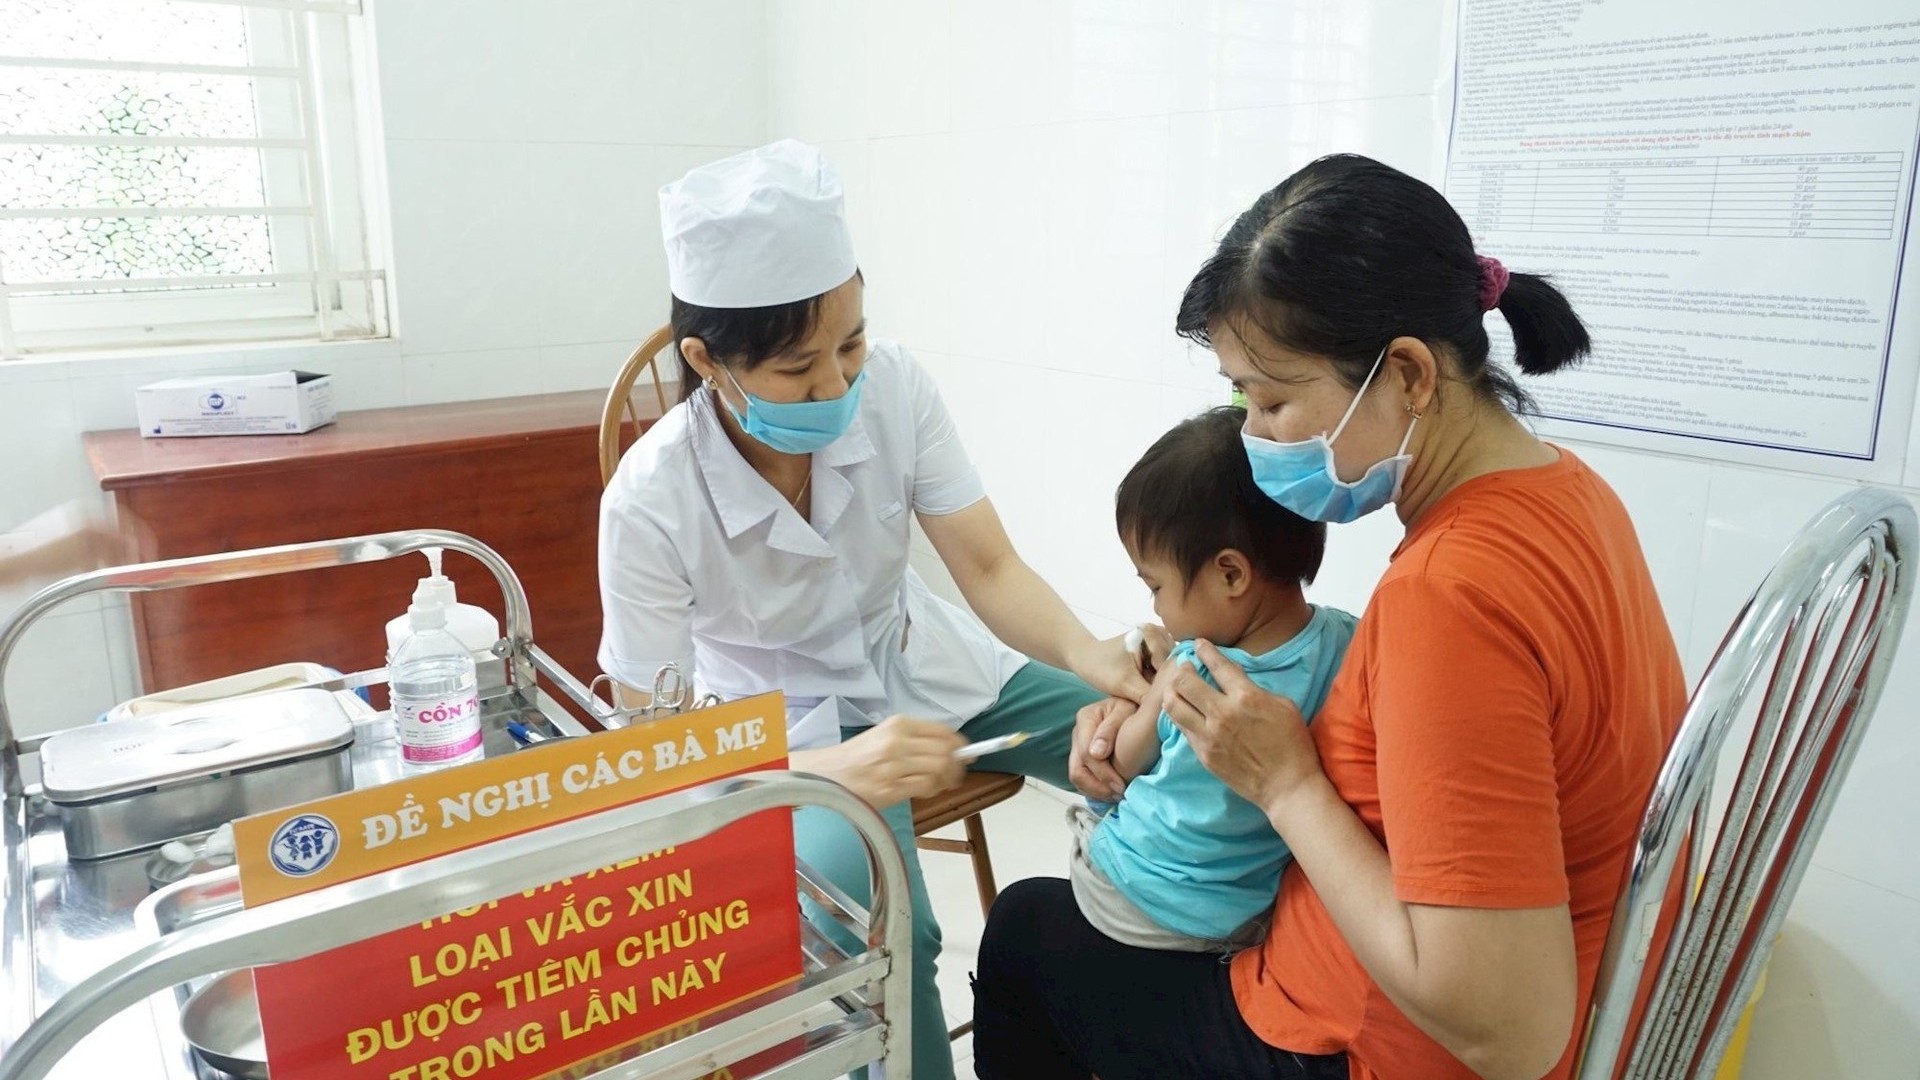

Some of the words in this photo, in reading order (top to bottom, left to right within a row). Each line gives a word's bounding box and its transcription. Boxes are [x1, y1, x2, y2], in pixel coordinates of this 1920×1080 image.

[418, 701, 462, 724] CỒN
[362, 793, 428, 849] ĐỀ
[438, 772, 552, 829] NGHỊ
[562, 752, 644, 794] CÁC
[653, 728, 707, 772] BÀ
[715, 717, 767, 755] MẸ
[346, 992, 483, 1065] ĐƯỢC
[496, 948, 602, 1009] TIÊM
[616, 899, 750, 968] CHỦNG
[409, 926, 512, 988] LOẠI
[526, 893, 613, 947] VẮC
[626, 868, 693, 917] XIN
[389, 1022, 546, 1080] TRONG
[559, 988, 638, 1040] LẦN
[651, 952, 726, 1006] NÀY
